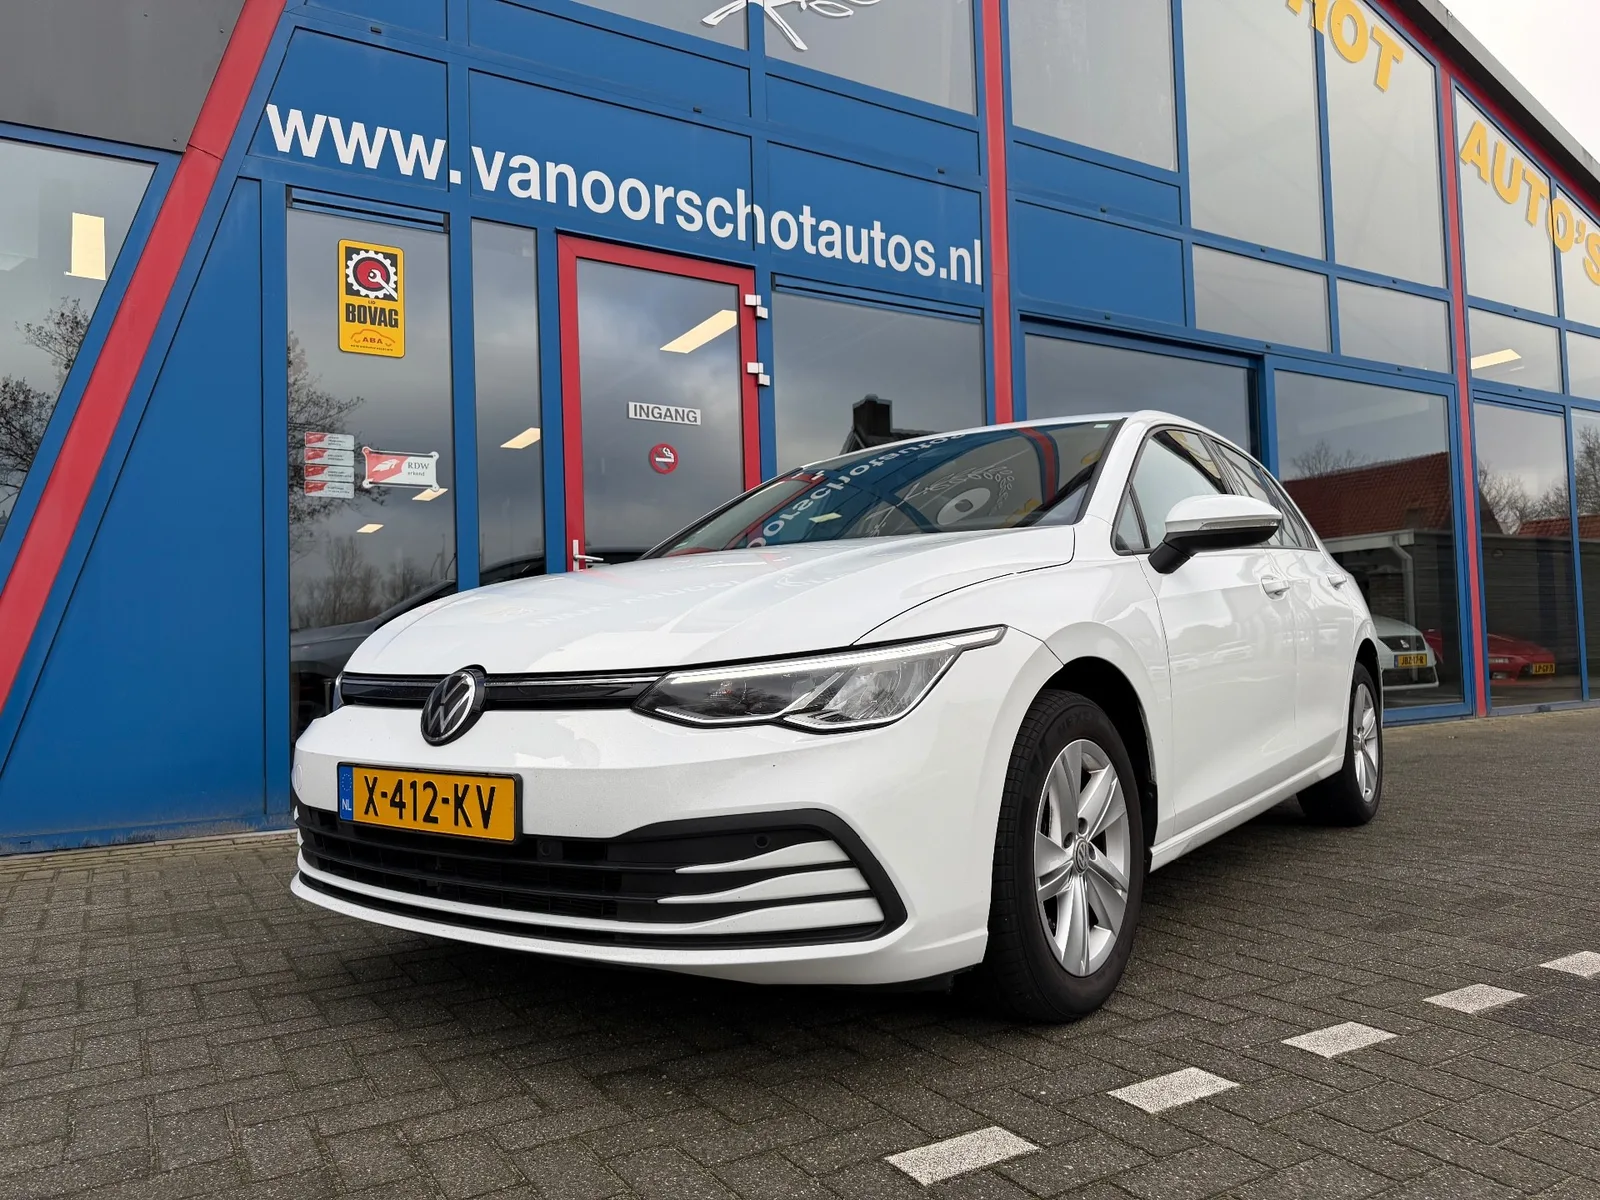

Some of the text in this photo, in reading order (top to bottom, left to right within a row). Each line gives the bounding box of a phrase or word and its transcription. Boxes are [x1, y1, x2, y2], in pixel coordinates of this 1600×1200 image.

[266, 103, 982, 286] www.vanoorschotautos.nl
[345, 302, 399, 328] BOVAG
[362, 336, 383, 345] ABA
[633, 403, 698, 423] INGANG
[407, 462, 430, 470] RDW
[341, 799, 352, 811] NL
[363, 775, 497, 830] X-412-KV
